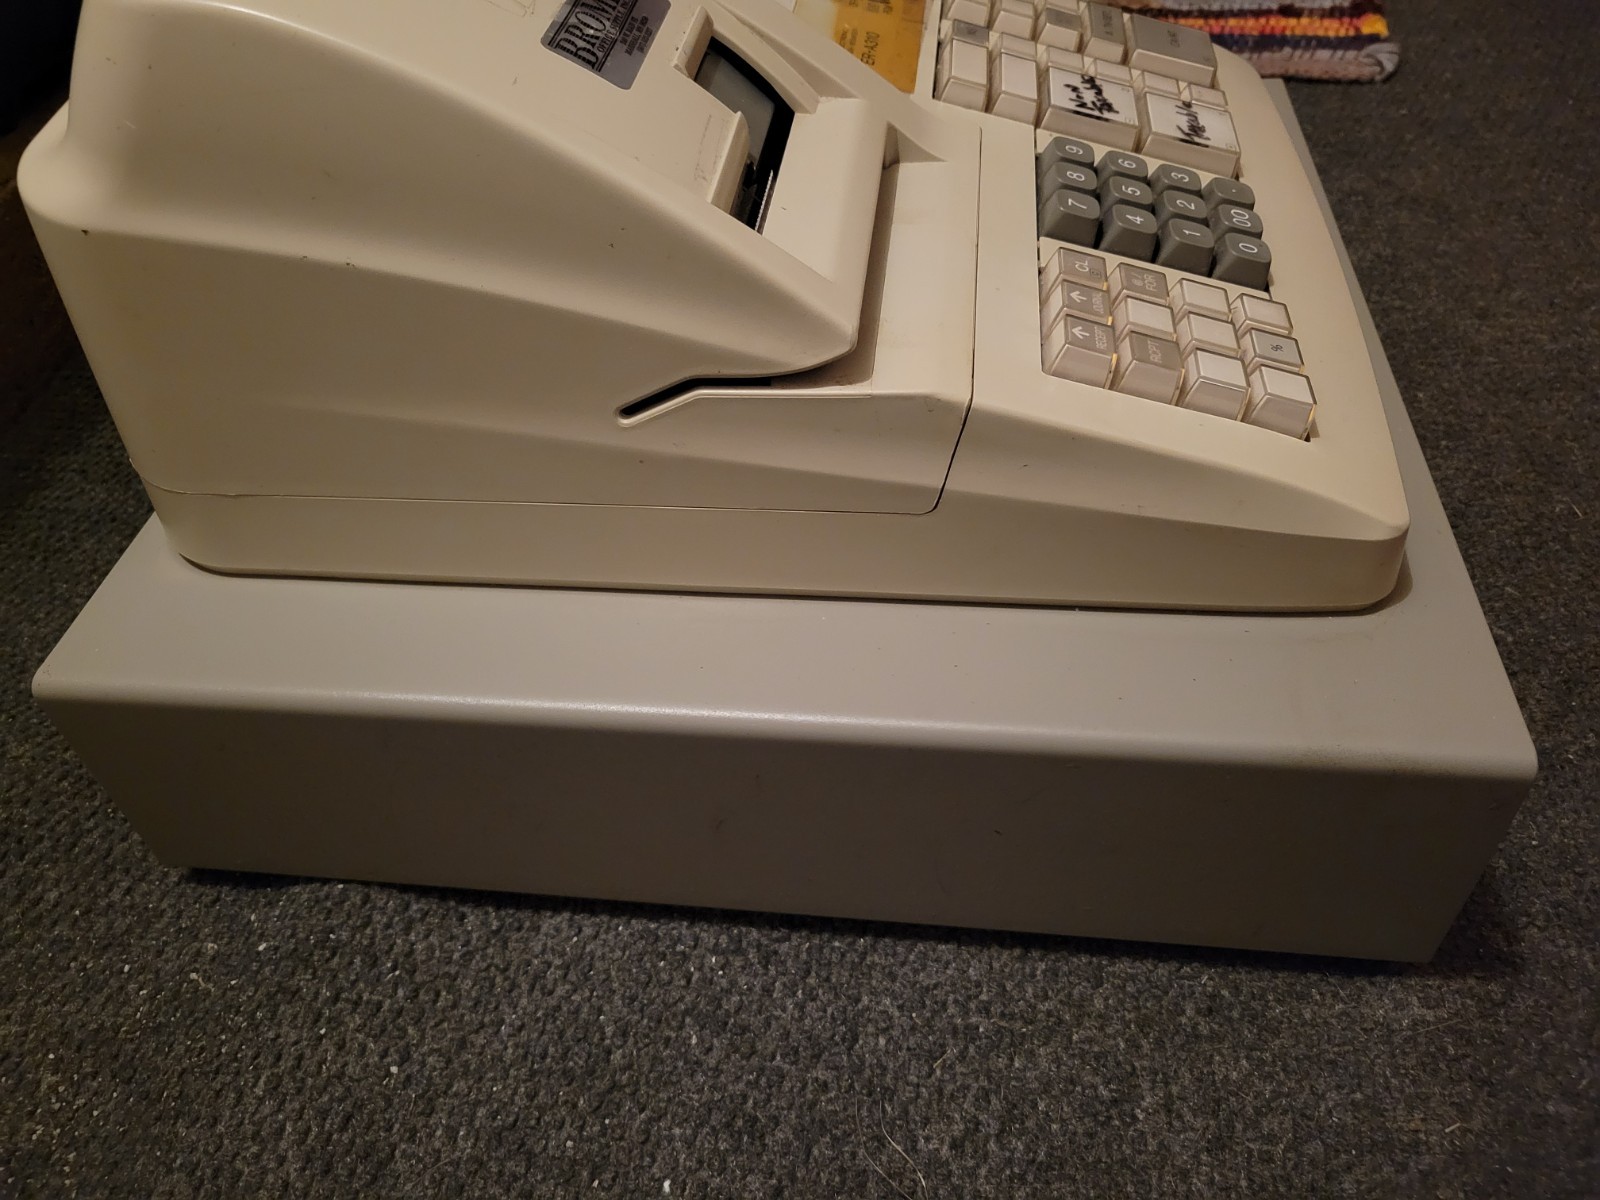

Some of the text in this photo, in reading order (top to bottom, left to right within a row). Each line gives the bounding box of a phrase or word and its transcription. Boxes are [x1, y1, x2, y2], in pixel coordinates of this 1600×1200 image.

[557, 0, 619, 69] BROM
[597, 29, 618, 53] OFFICE
[860, 31, 880, 66] ER-A310
[1065, 145, 1084, 155] 9
[1118, 159, 1137, 169] 6
[1066, 170, 1086, 181] 8
[1171, 171, 1190, 182] 3
[1122, 185, 1141, 196] 5
[1067, 197, 1088, 210] 7
[1176, 199, 1195, 210] 2
[1125, 213, 1144, 225] 4
[1230, 208, 1252, 228] 00
[1182, 229, 1201, 237] 1
[1238, 242, 1258, 253] 0
[1074, 258, 1091, 273] CL
[1144, 268, 1162, 291] FOR
[1094, 324, 1110, 352] RECEIPT
[1146, 339, 1164, 364] RCPT
[1270, 343, 1285, 354] %
